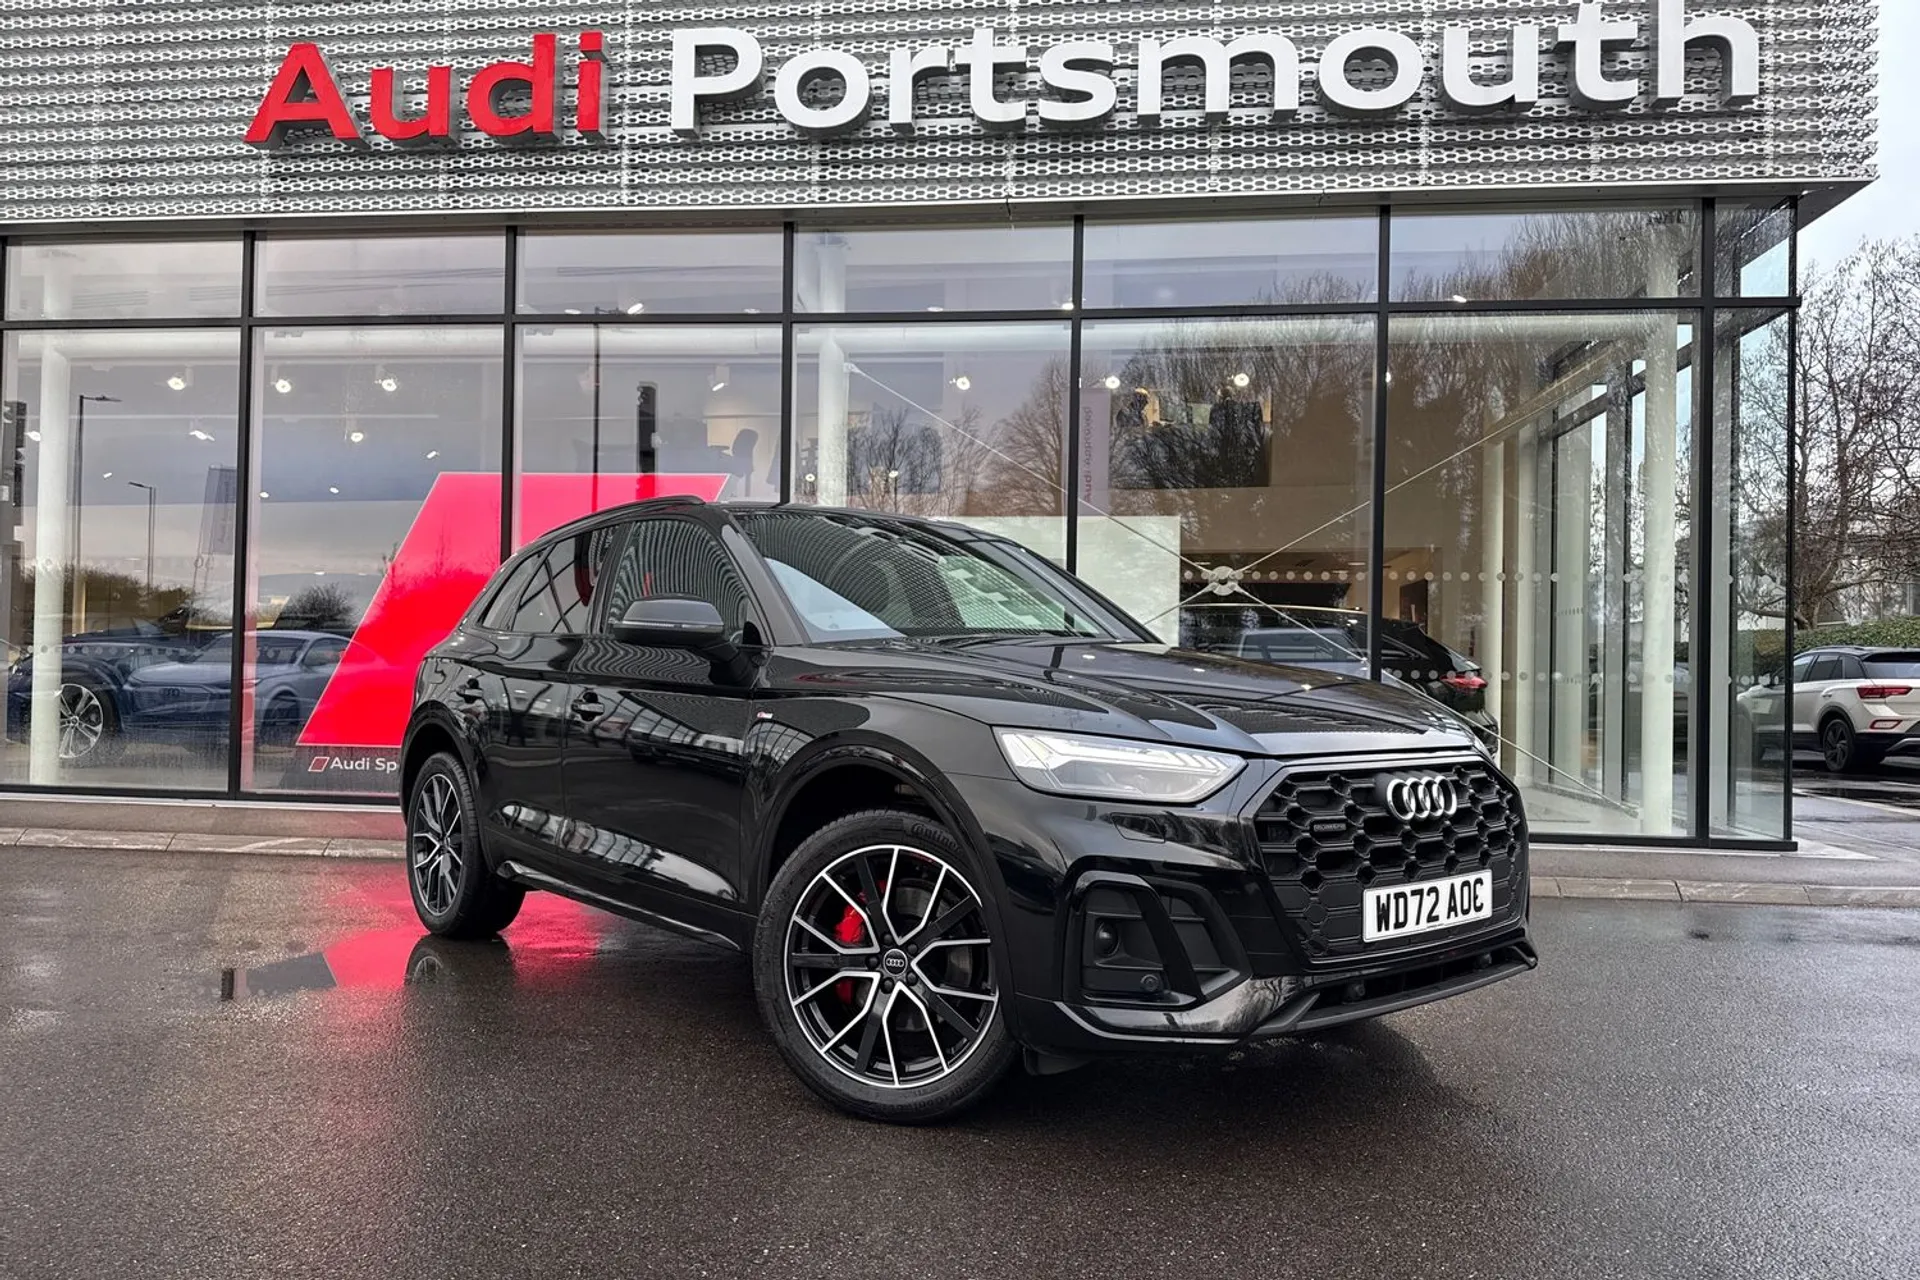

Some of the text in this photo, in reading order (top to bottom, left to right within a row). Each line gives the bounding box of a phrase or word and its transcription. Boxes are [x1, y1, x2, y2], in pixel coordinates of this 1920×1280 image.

[243, 0, 1759, 144] Audi Portsmouth
[330, 757, 399, 774] Audi Sp
[1376, 877, 1484, 932] WD72 AOC
